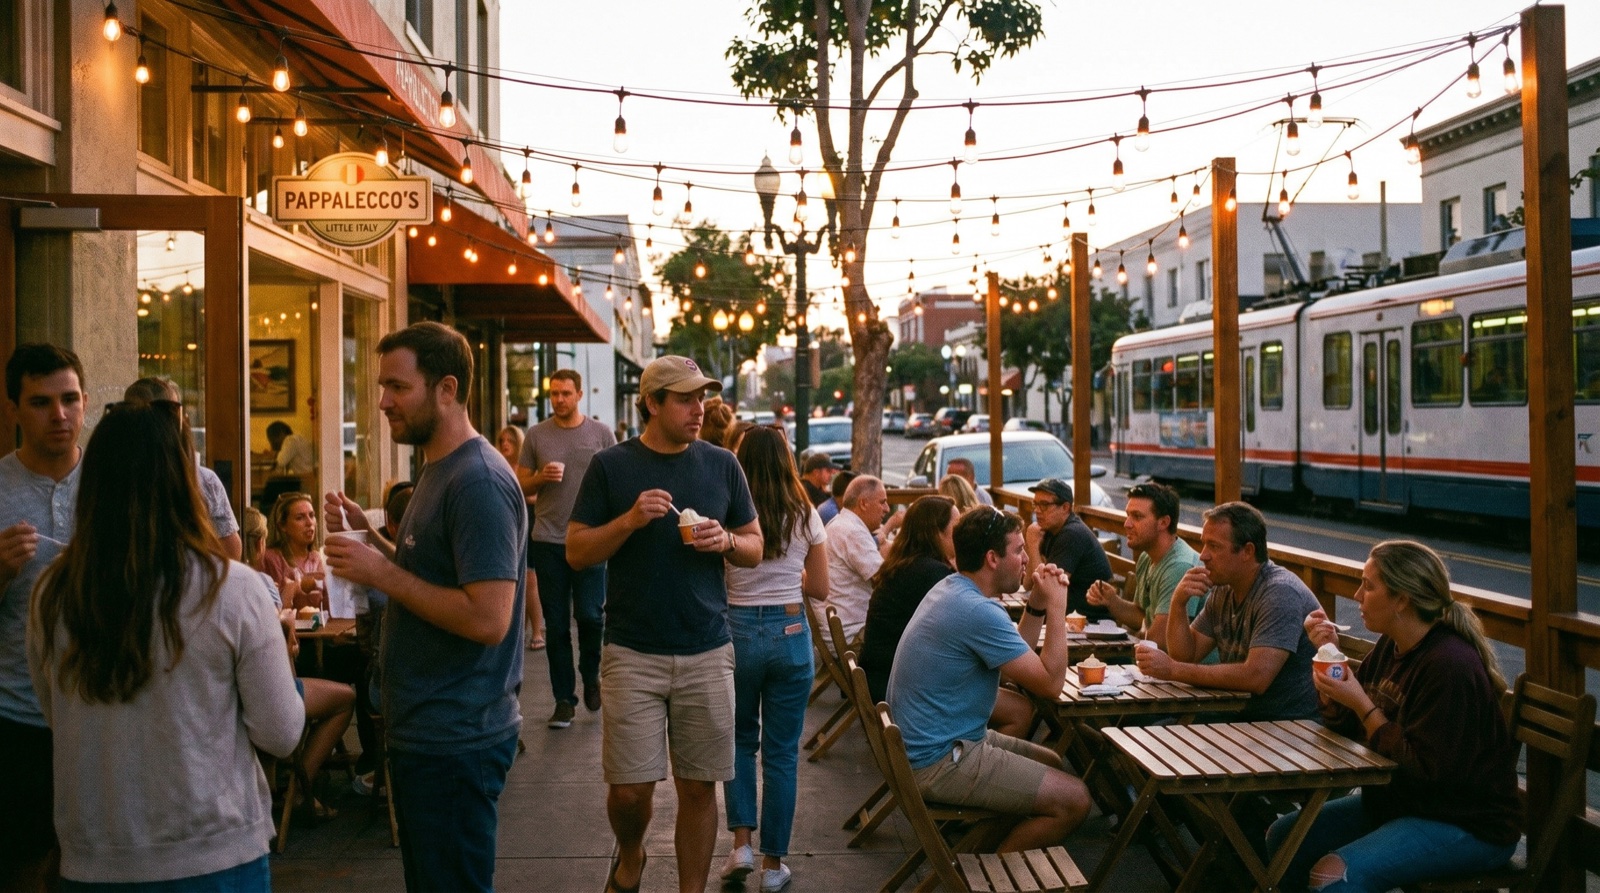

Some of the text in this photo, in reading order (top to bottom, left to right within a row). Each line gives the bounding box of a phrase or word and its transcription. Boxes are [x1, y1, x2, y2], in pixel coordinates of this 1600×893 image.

[285, 191, 419, 209] PAPPALECCO'S
[325, 223, 379, 233] LITTLE ITALY
